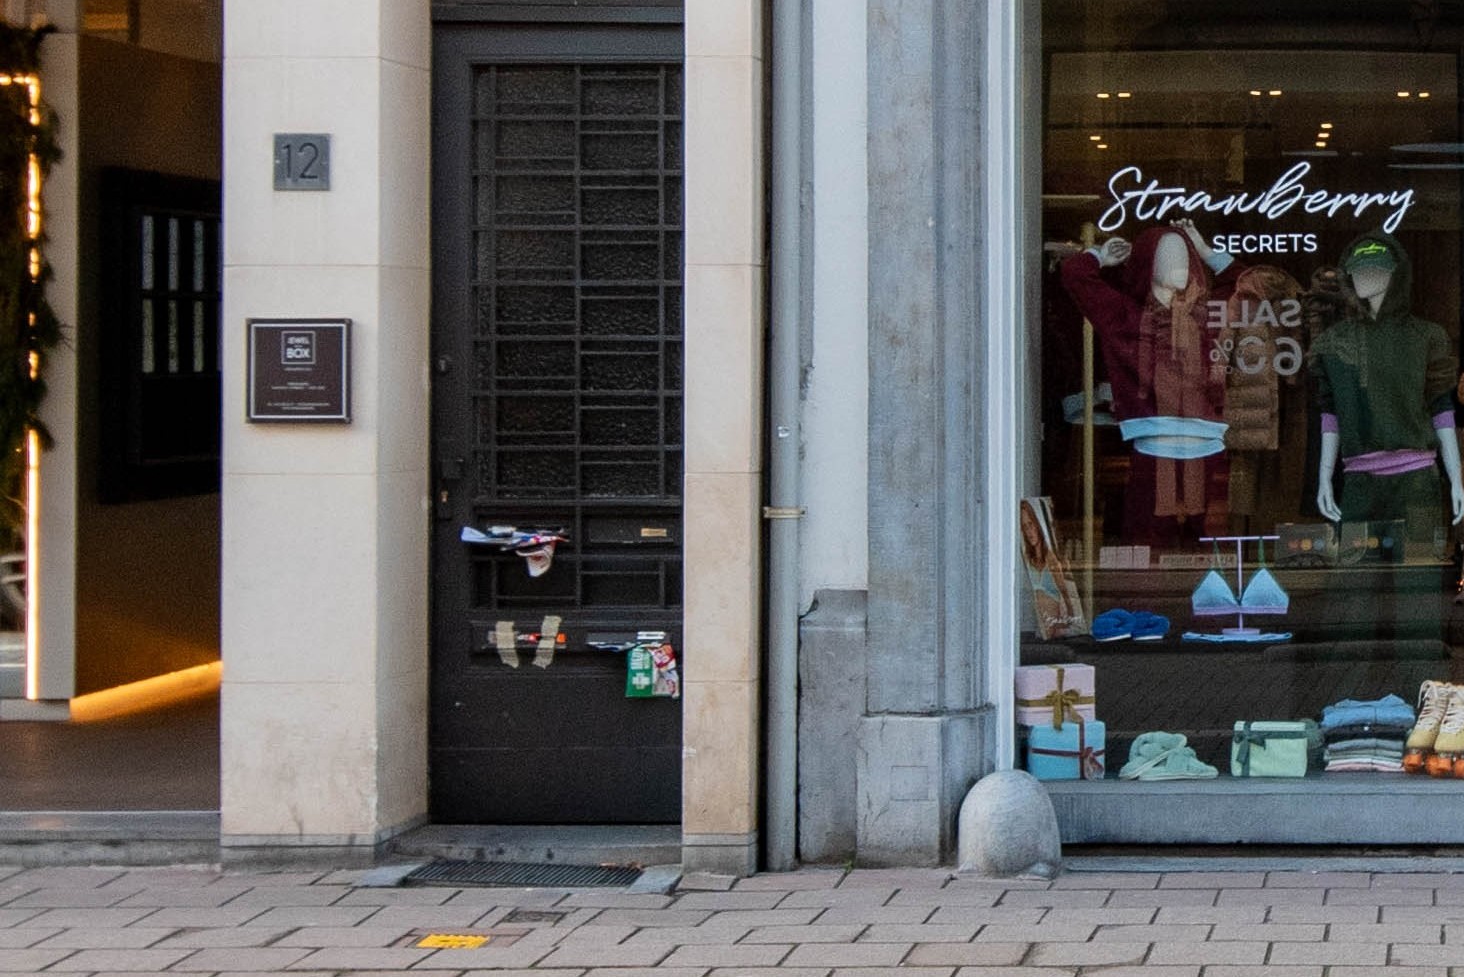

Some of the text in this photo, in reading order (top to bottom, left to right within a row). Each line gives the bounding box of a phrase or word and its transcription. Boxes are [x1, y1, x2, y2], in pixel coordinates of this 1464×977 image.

[282, 142, 319, 179] 12
[1098, 161, 1416, 235] Strawberry
[1212, 232, 1318, 254] SECRETS
[286, 348, 311, 359] BOX
